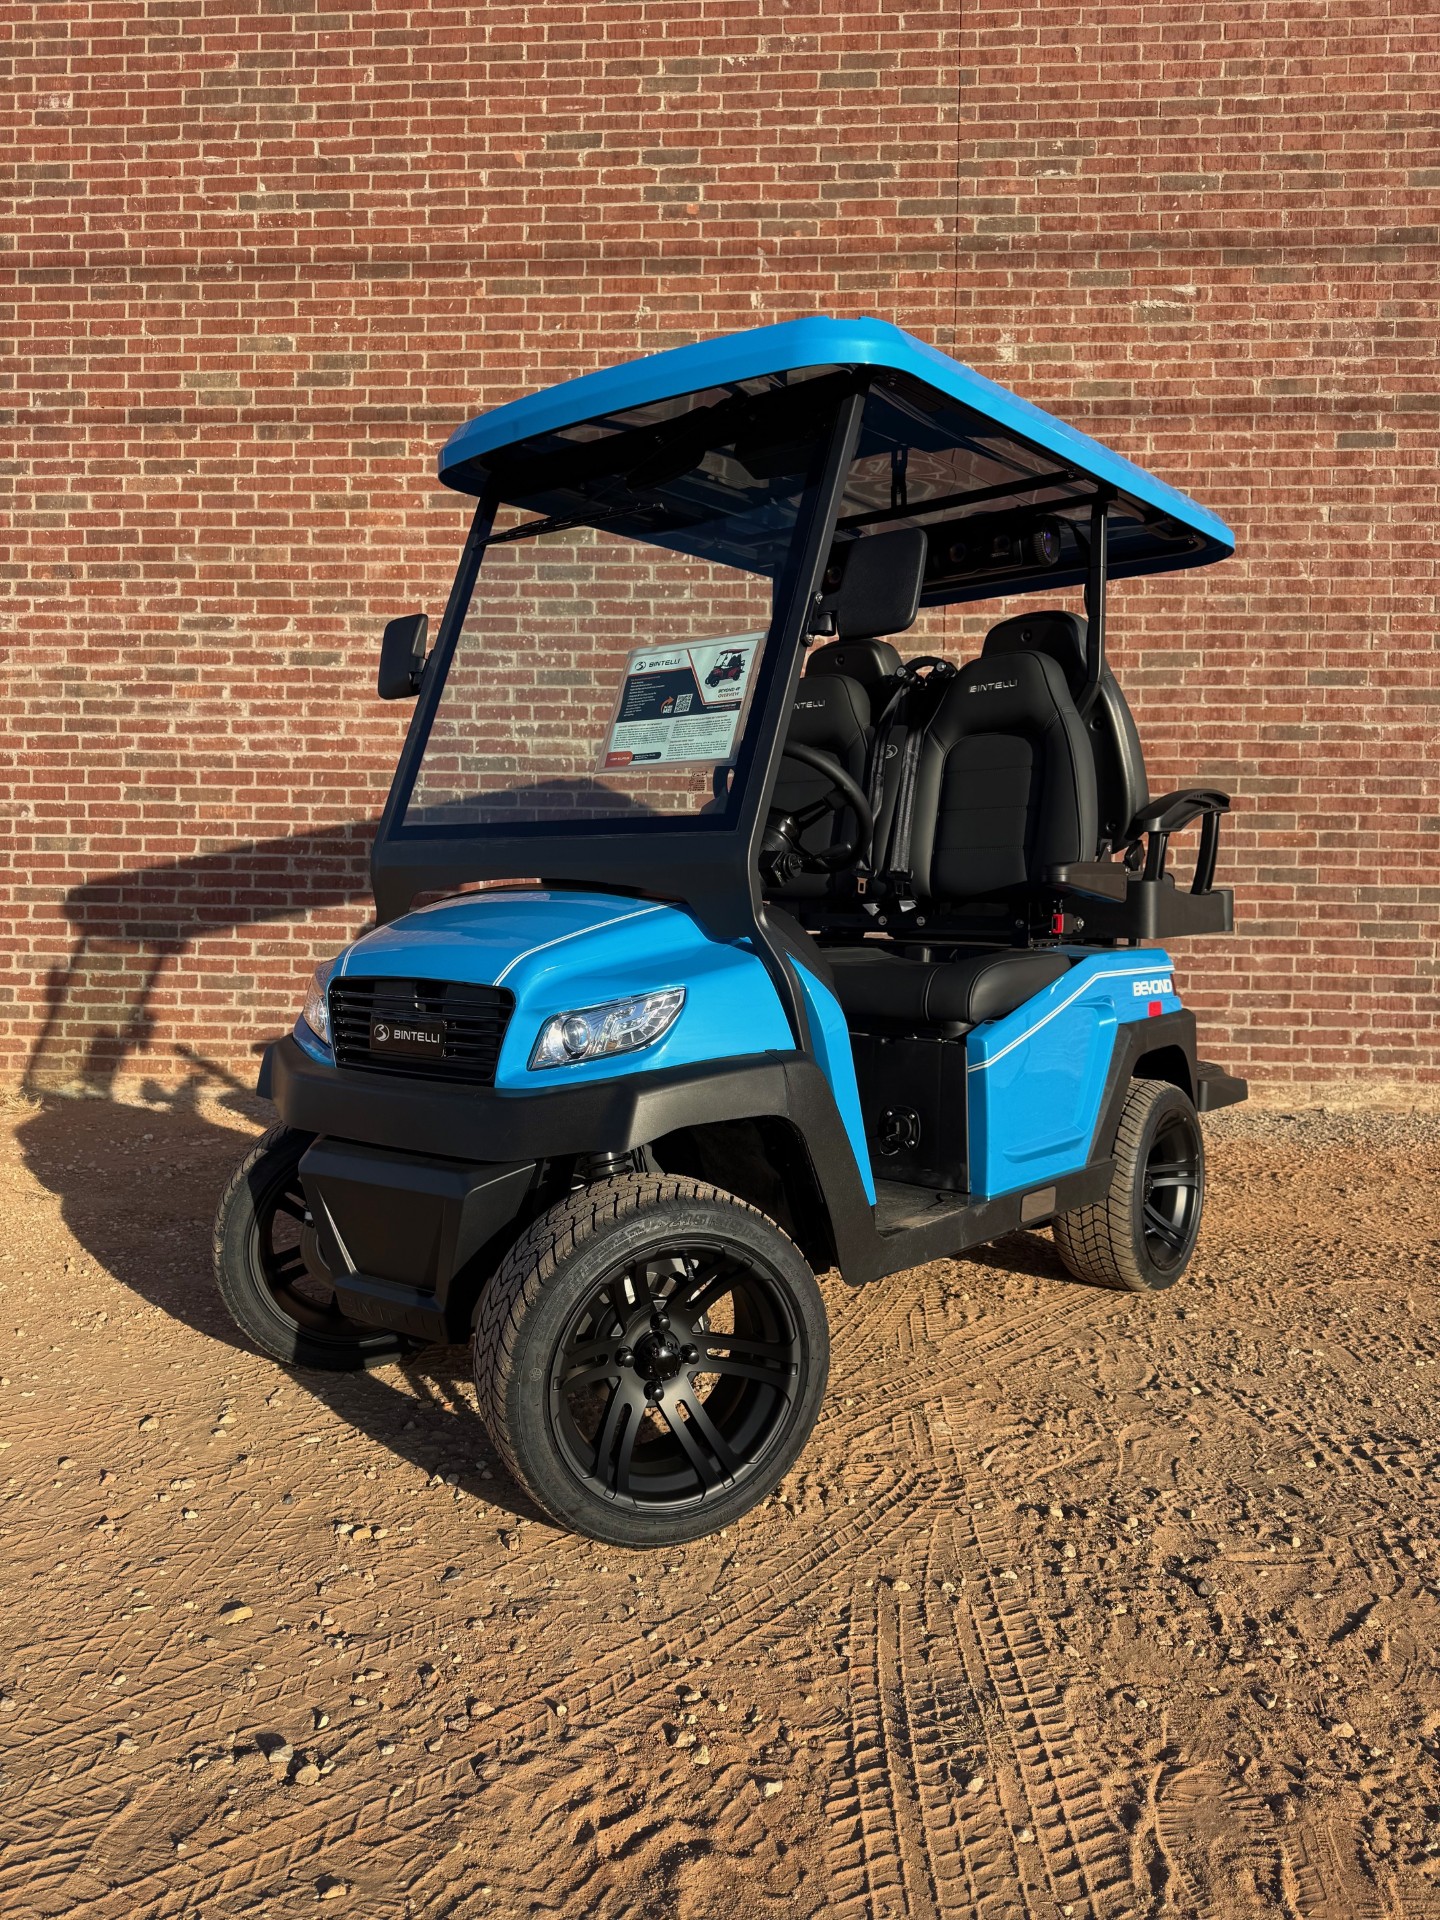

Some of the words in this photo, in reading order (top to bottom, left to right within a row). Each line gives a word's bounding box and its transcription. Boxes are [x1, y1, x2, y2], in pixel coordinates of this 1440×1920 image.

[648, 659, 681, 668] BINTELLI
[969, 679, 1018, 693] BINTELLI
[1132, 978, 1173, 997] BEYOND
[393, 1029, 440, 1044] BINTELLI
